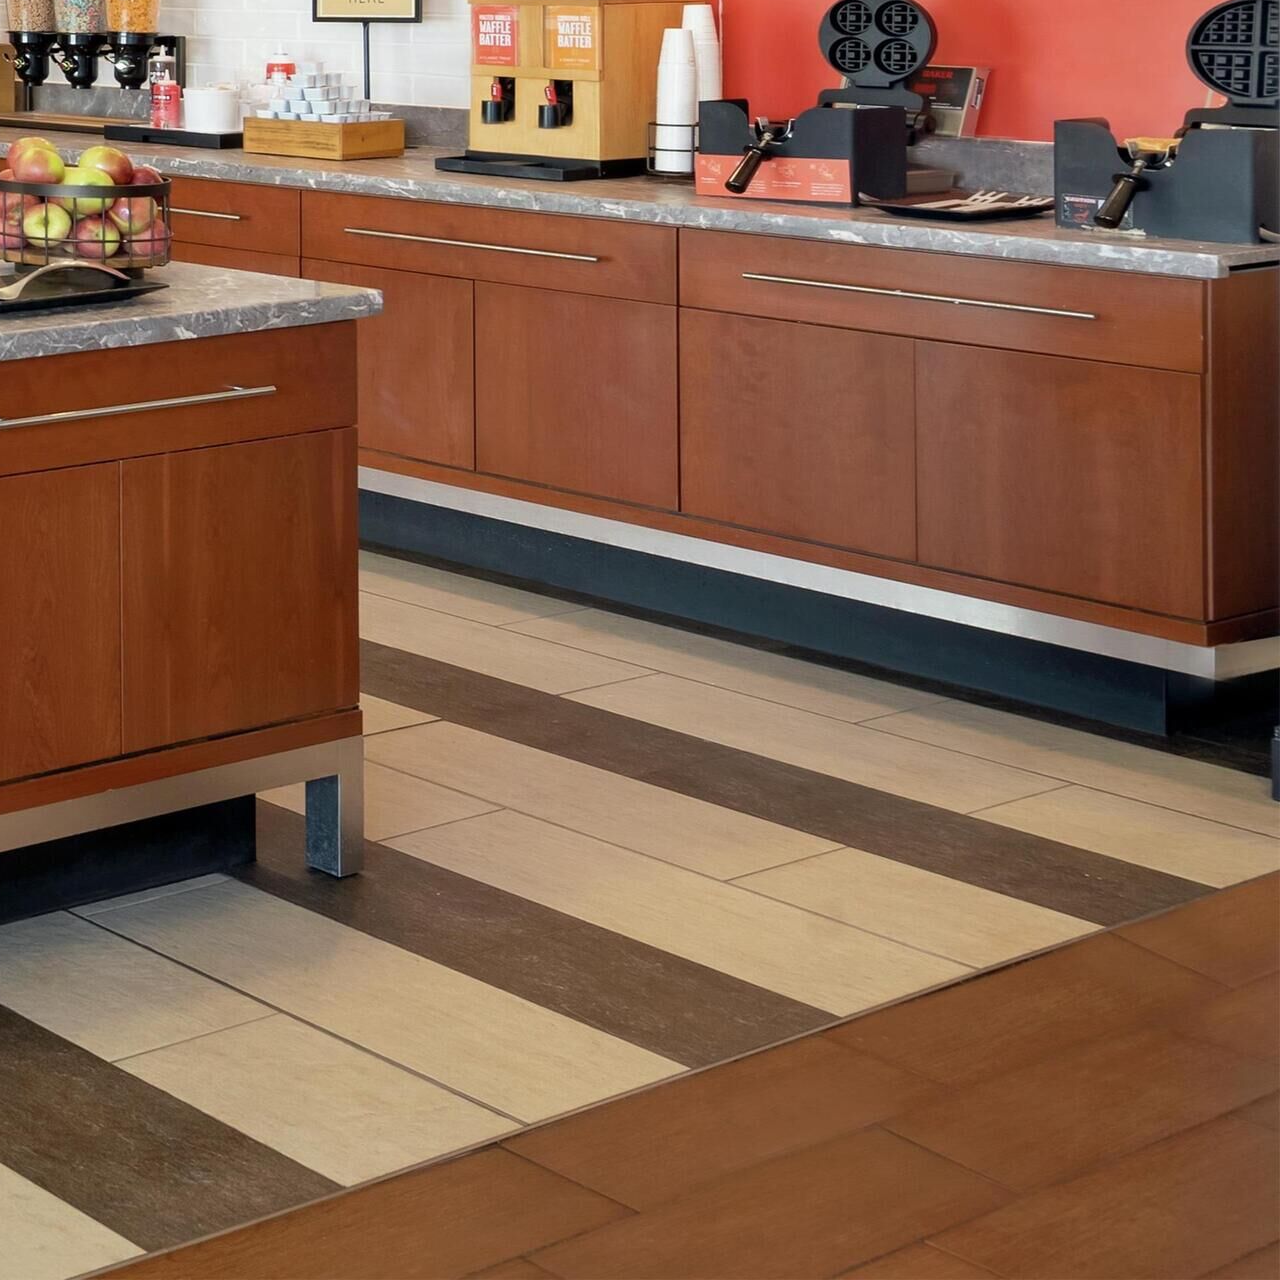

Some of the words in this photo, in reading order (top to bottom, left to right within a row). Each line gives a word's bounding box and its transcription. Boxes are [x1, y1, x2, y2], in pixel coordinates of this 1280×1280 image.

[479, 20, 511, 34] WAFFLE
[557, 22, 592, 35] WAFFLE
[479, 33, 512, 47] BATTER
[557, 35, 592, 48] BATTER
